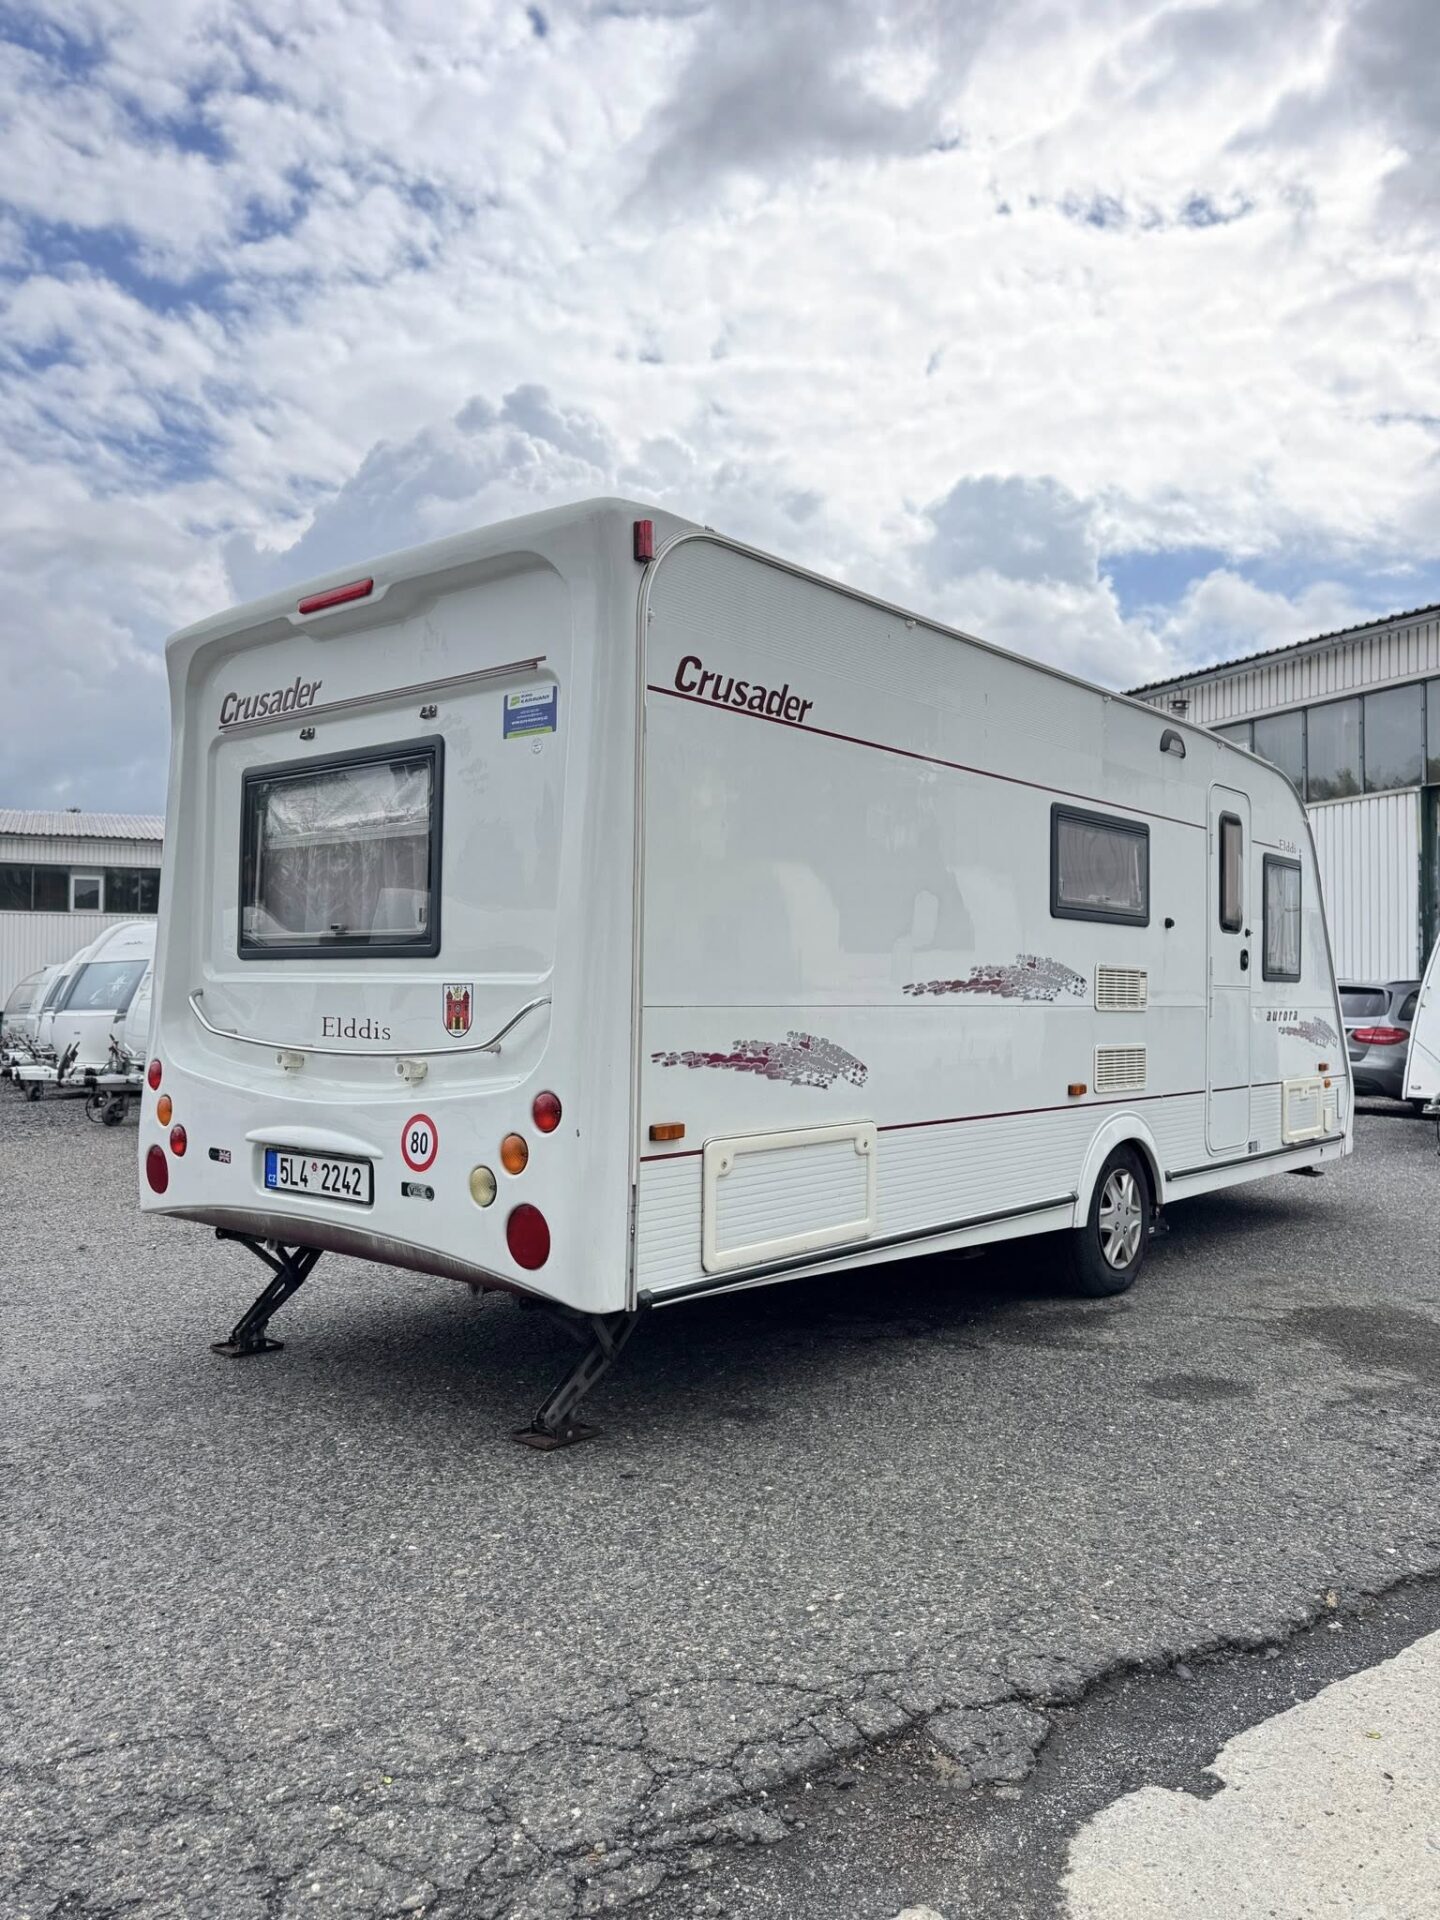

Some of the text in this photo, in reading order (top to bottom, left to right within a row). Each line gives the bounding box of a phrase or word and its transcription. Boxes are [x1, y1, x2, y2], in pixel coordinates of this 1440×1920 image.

[220, 676, 323, 724] Crusader
[674, 655, 813, 722] Crusader
[321, 1016, 391, 1040] Elddis
[1266, 1010, 1298, 1022] aurora
[410, 1131, 428, 1155] 80
[268, 1174, 276, 1183] CZ
[280, 1157, 362, 1197] 5L4 2242
